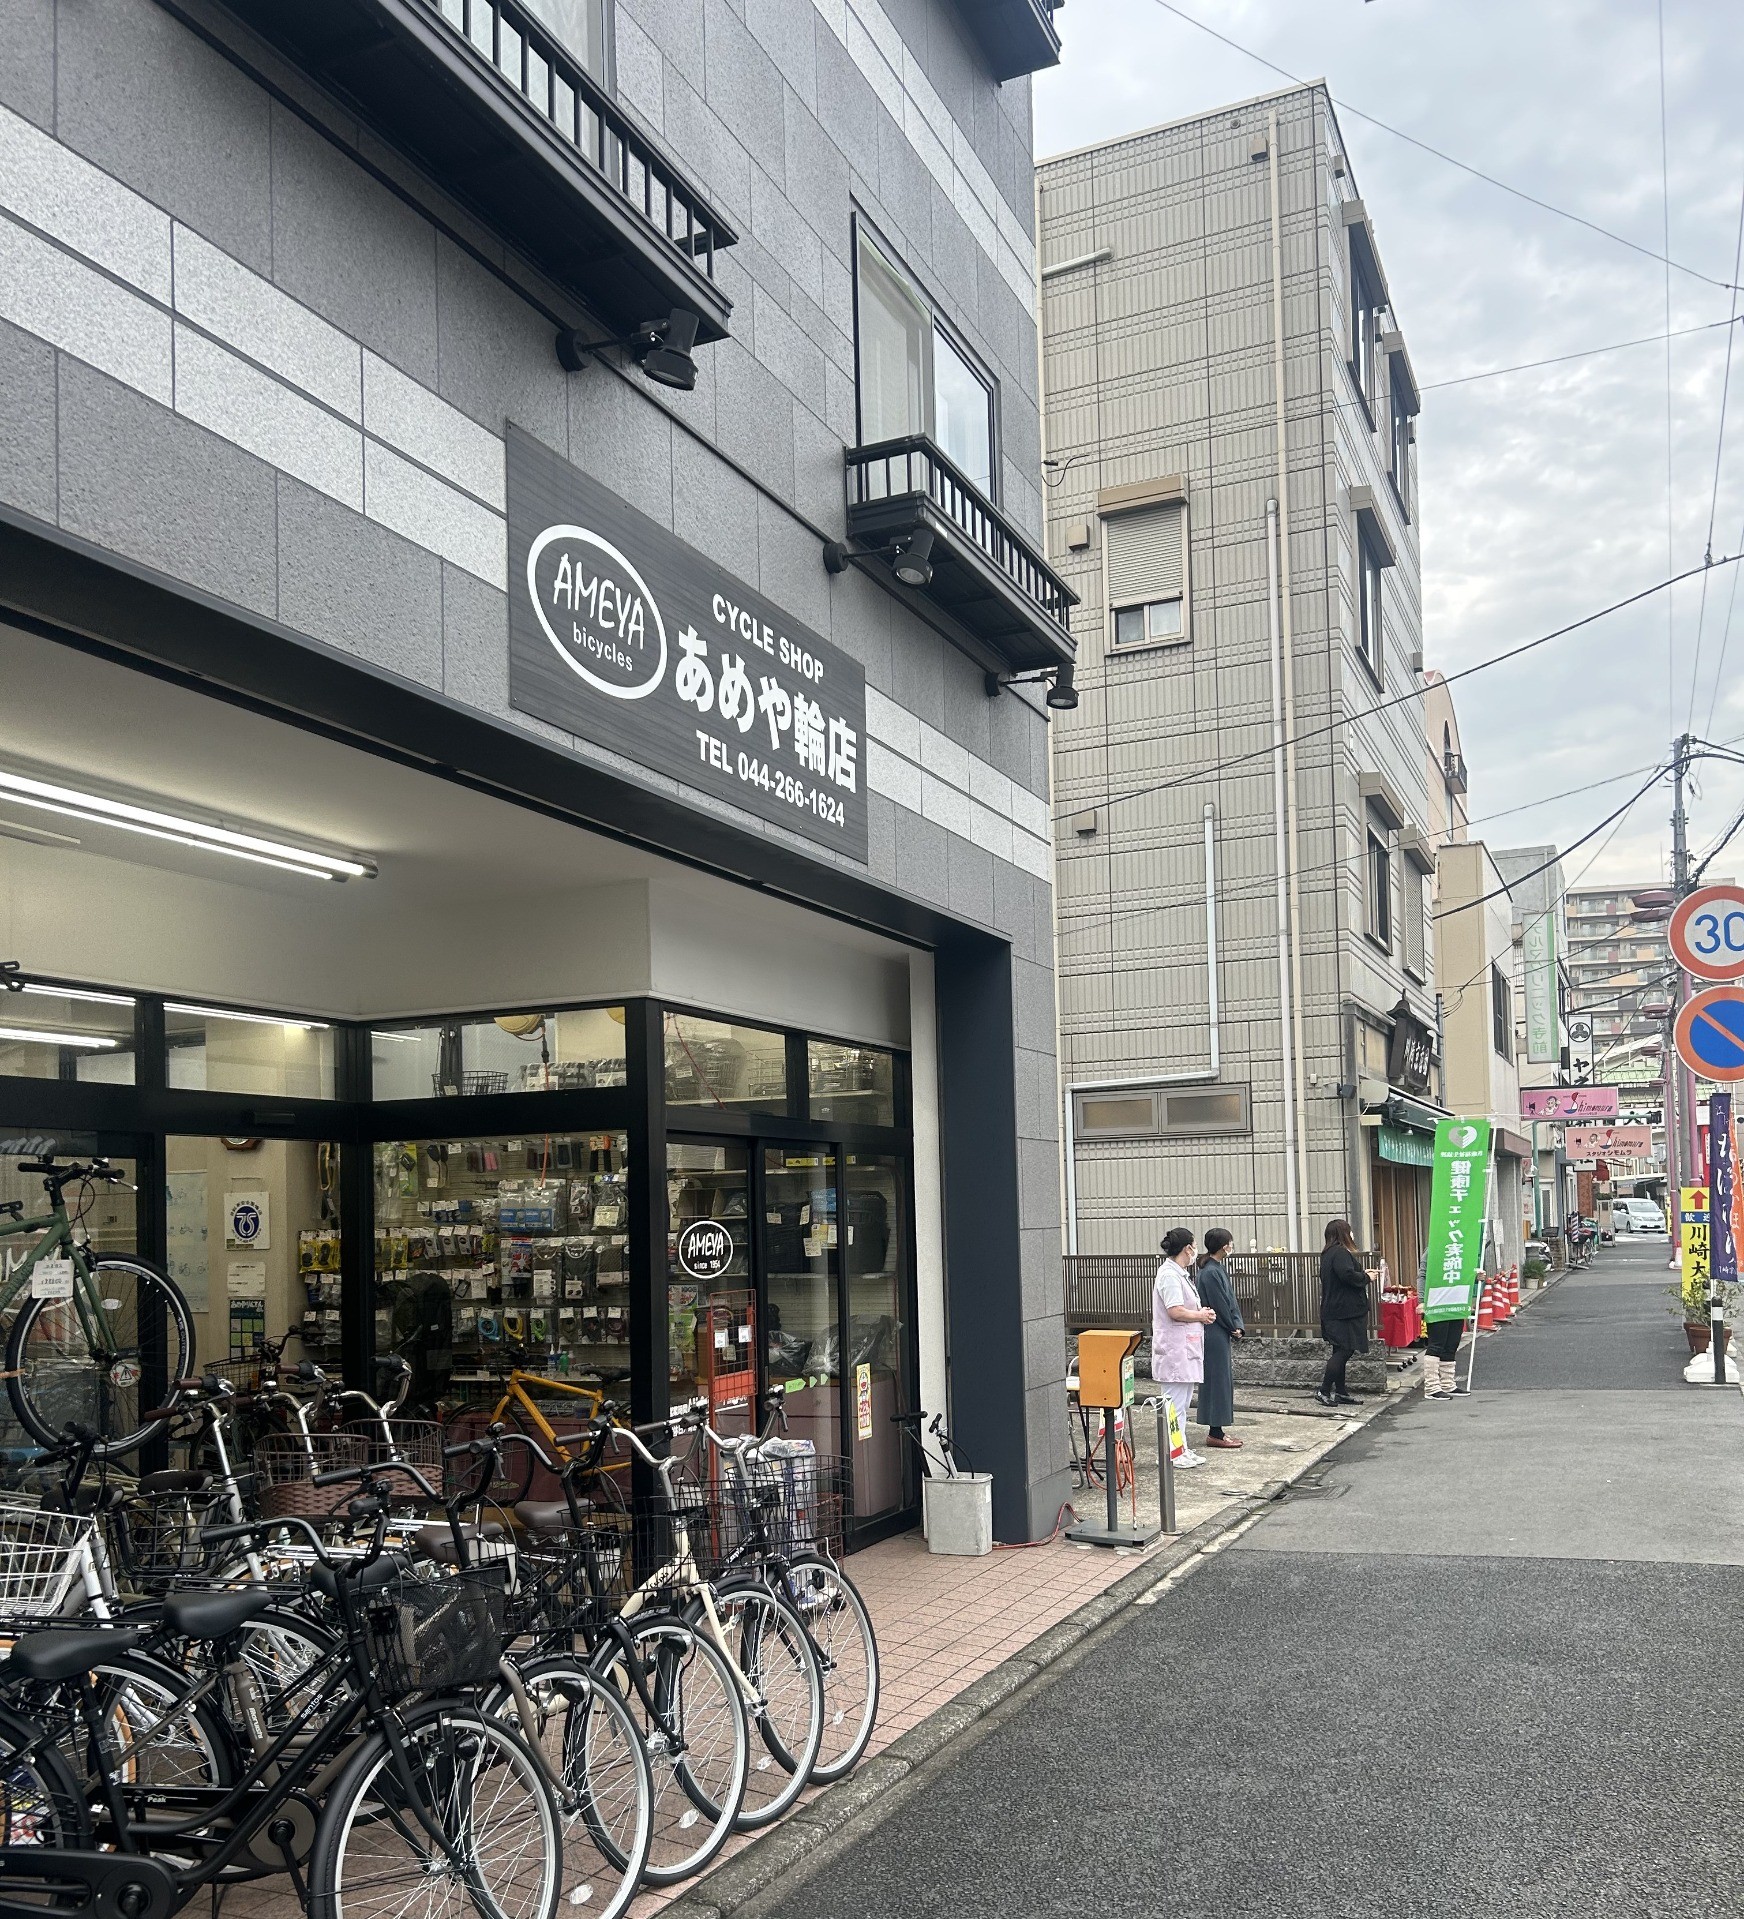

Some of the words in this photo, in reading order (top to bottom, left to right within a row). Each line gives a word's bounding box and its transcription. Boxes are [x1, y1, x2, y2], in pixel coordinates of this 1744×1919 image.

[554, 553, 644, 650] AMEYA
[573, 622, 633, 671] bicycles
[712, 593, 775, 656] CYCLE
[779, 636, 824, 684] SHOP
[675, 625, 857, 793] あめや輪店
[696, 729, 733, 775] TEL
[738, 752, 845, 828] 044-266-1624
[1695, 911, 1744, 954] 30
[688, 1231, 724, 1259] AMEYA
[693, 1261, 708, 1270] since
[147, 1795, 167, 1803] Peak
